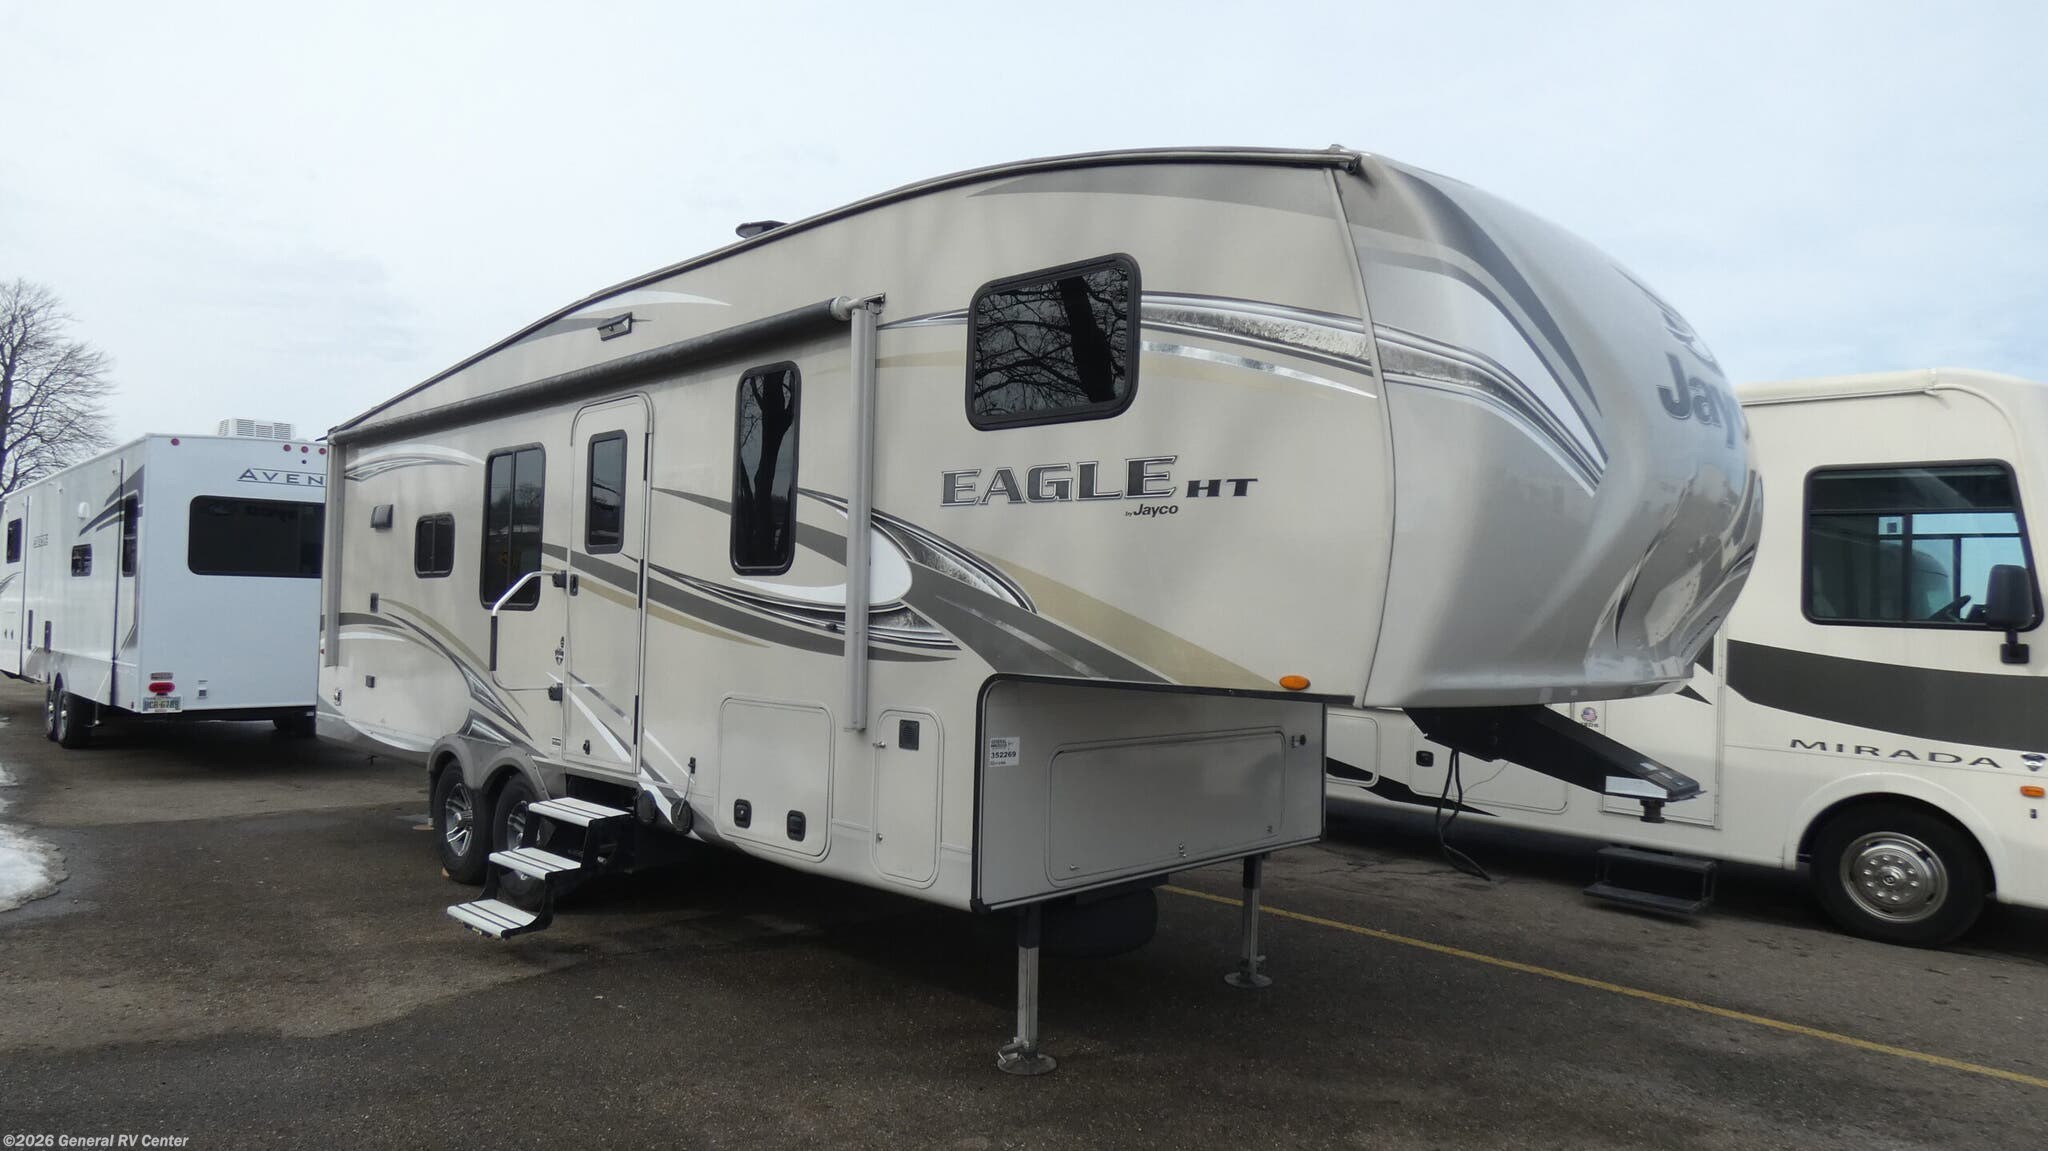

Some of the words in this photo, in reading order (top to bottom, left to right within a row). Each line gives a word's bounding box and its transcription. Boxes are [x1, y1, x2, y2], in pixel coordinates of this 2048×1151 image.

[1656, 350, 1750, 450] Jay
[941, 455, 1177, 508] EAGLE
[1186, 478, 1258, 499] HT
[1133, 503, 1179, 518] Jayco
[1789, 738, 2002, 769] MIRADA
